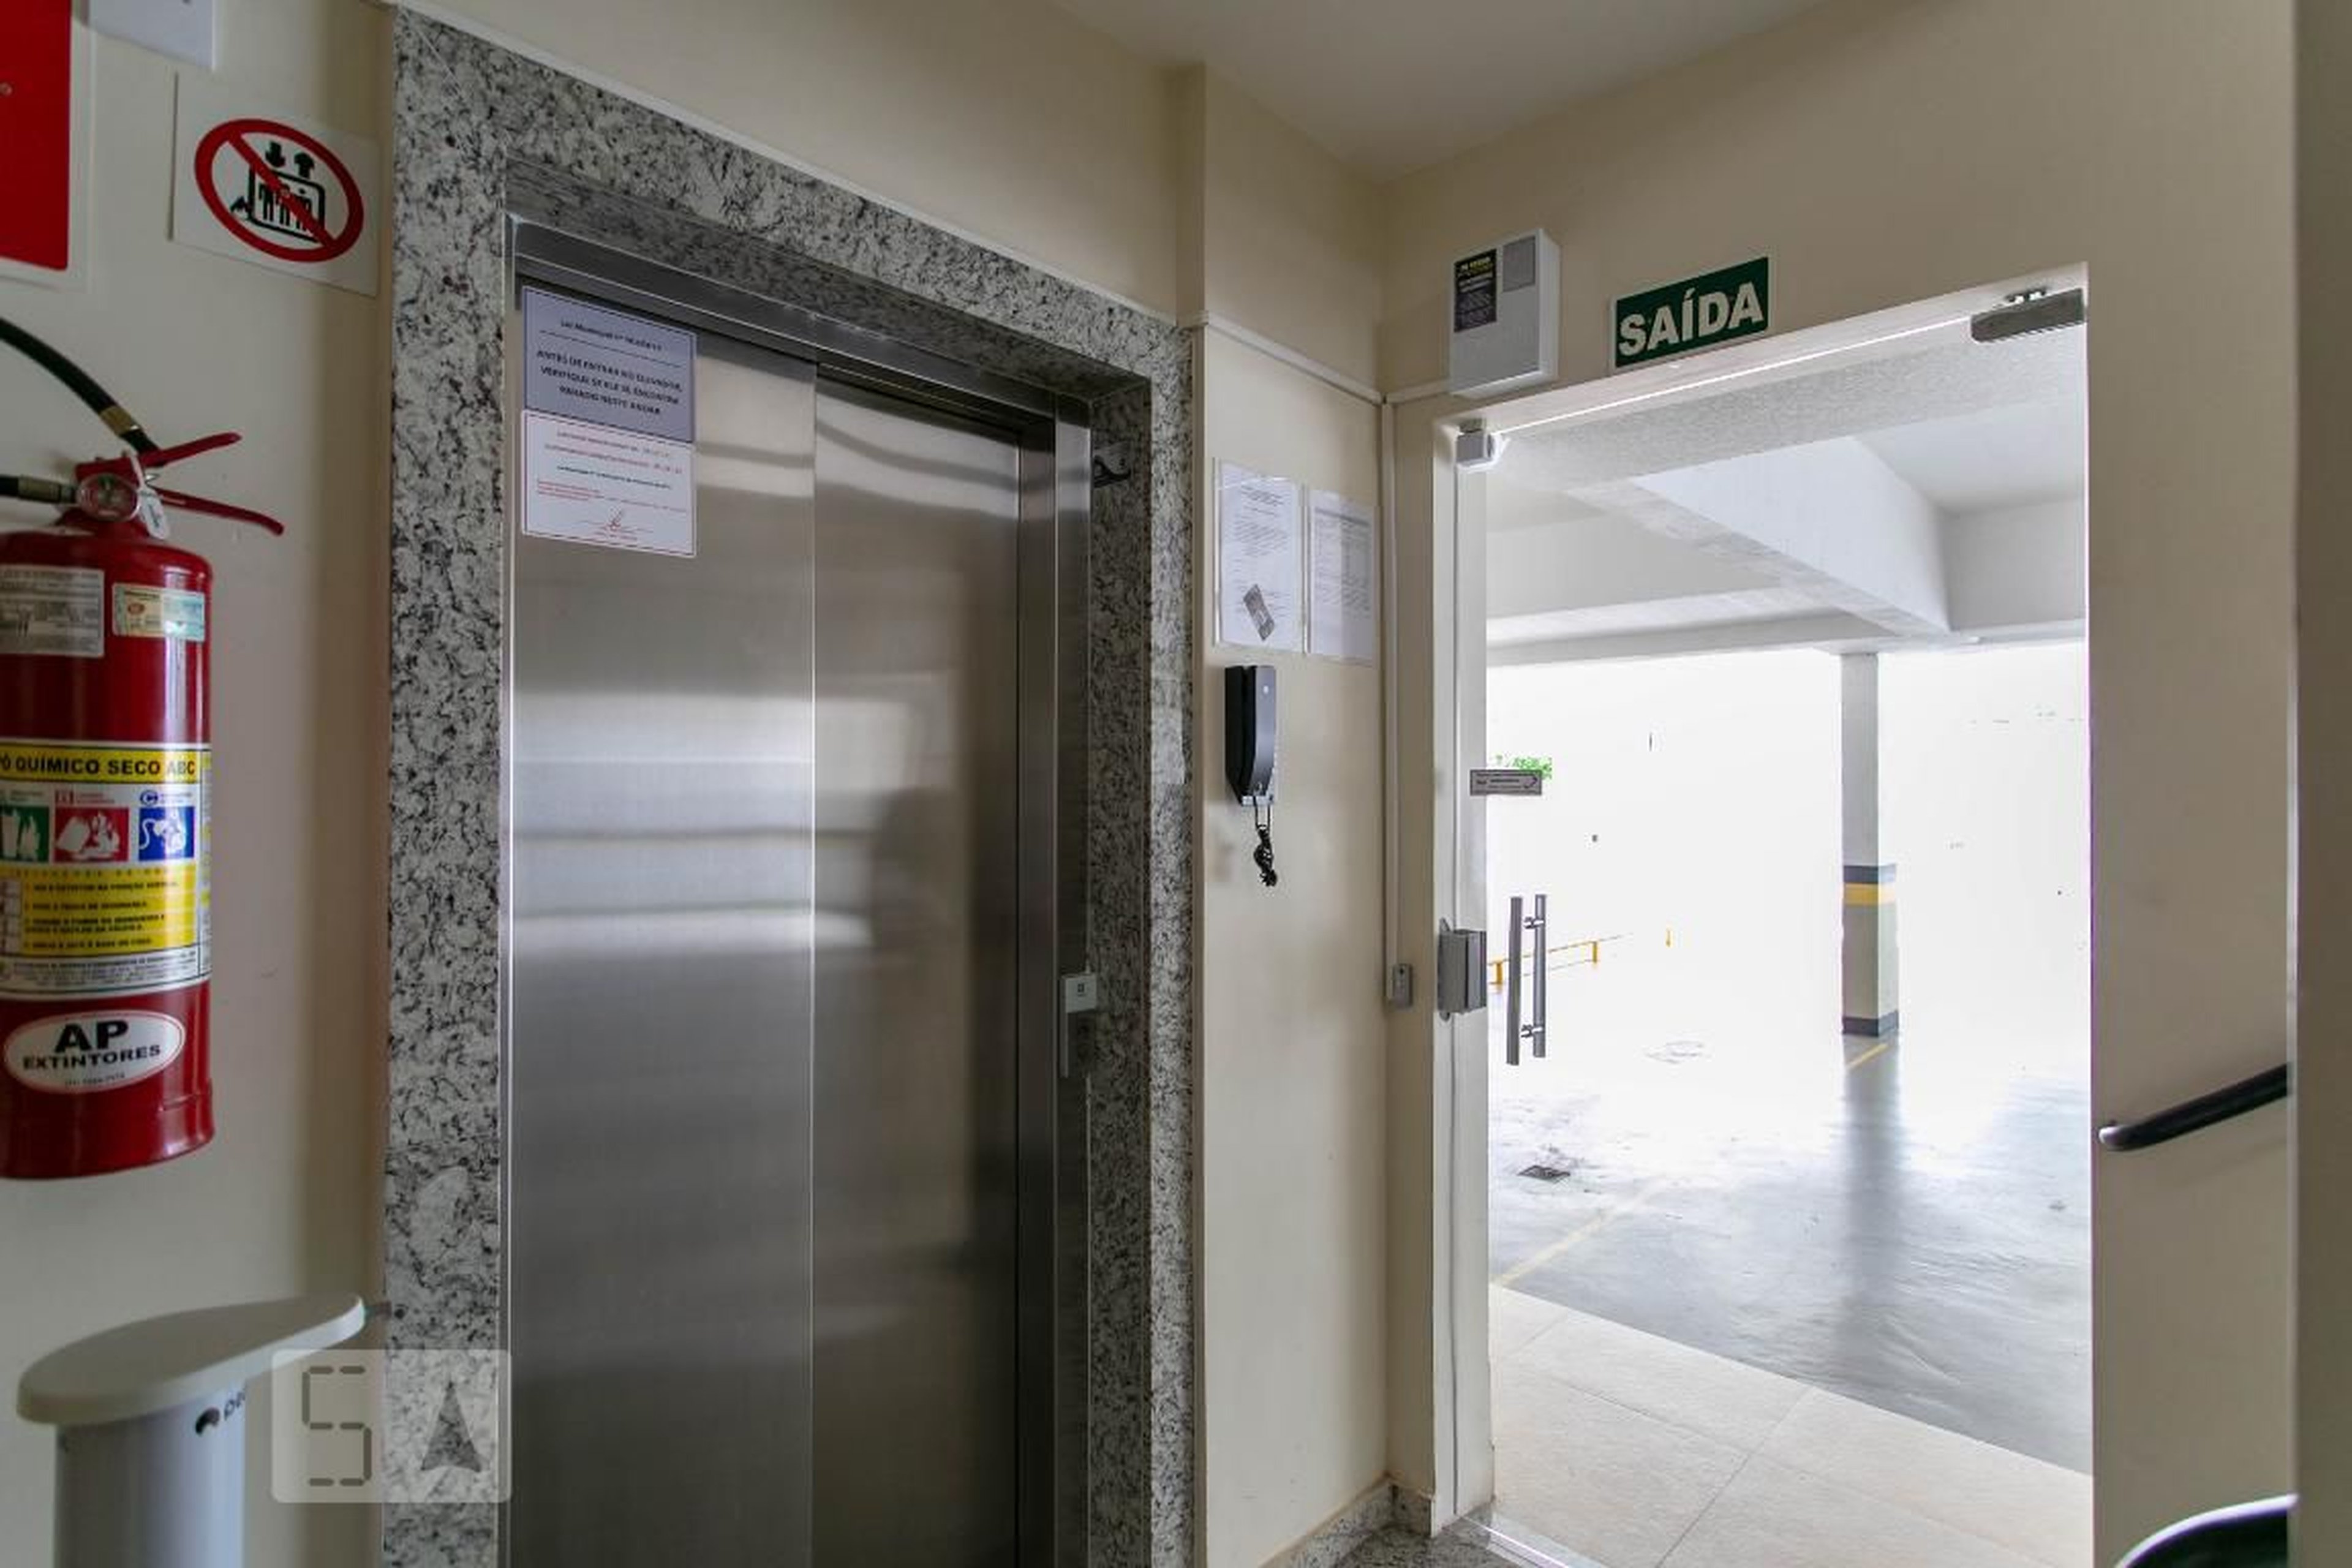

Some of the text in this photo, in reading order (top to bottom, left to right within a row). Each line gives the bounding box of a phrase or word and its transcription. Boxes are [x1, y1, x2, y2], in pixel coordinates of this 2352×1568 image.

[1618, 281, 1764, 356] SAÍDA
[537, 350, 568, 364] ANTES
[570, 356, 582, 367] DE
[583, 359, 619, 376] ENTRAR
[0, 753, 11, 772] Ó
[107, 760, 161, 775] SECO
[166, 760, 195, 775] ABC
[55, 1020, 129, 1053] AP
[23, 1044, 161, 1071] EXTINTORES
